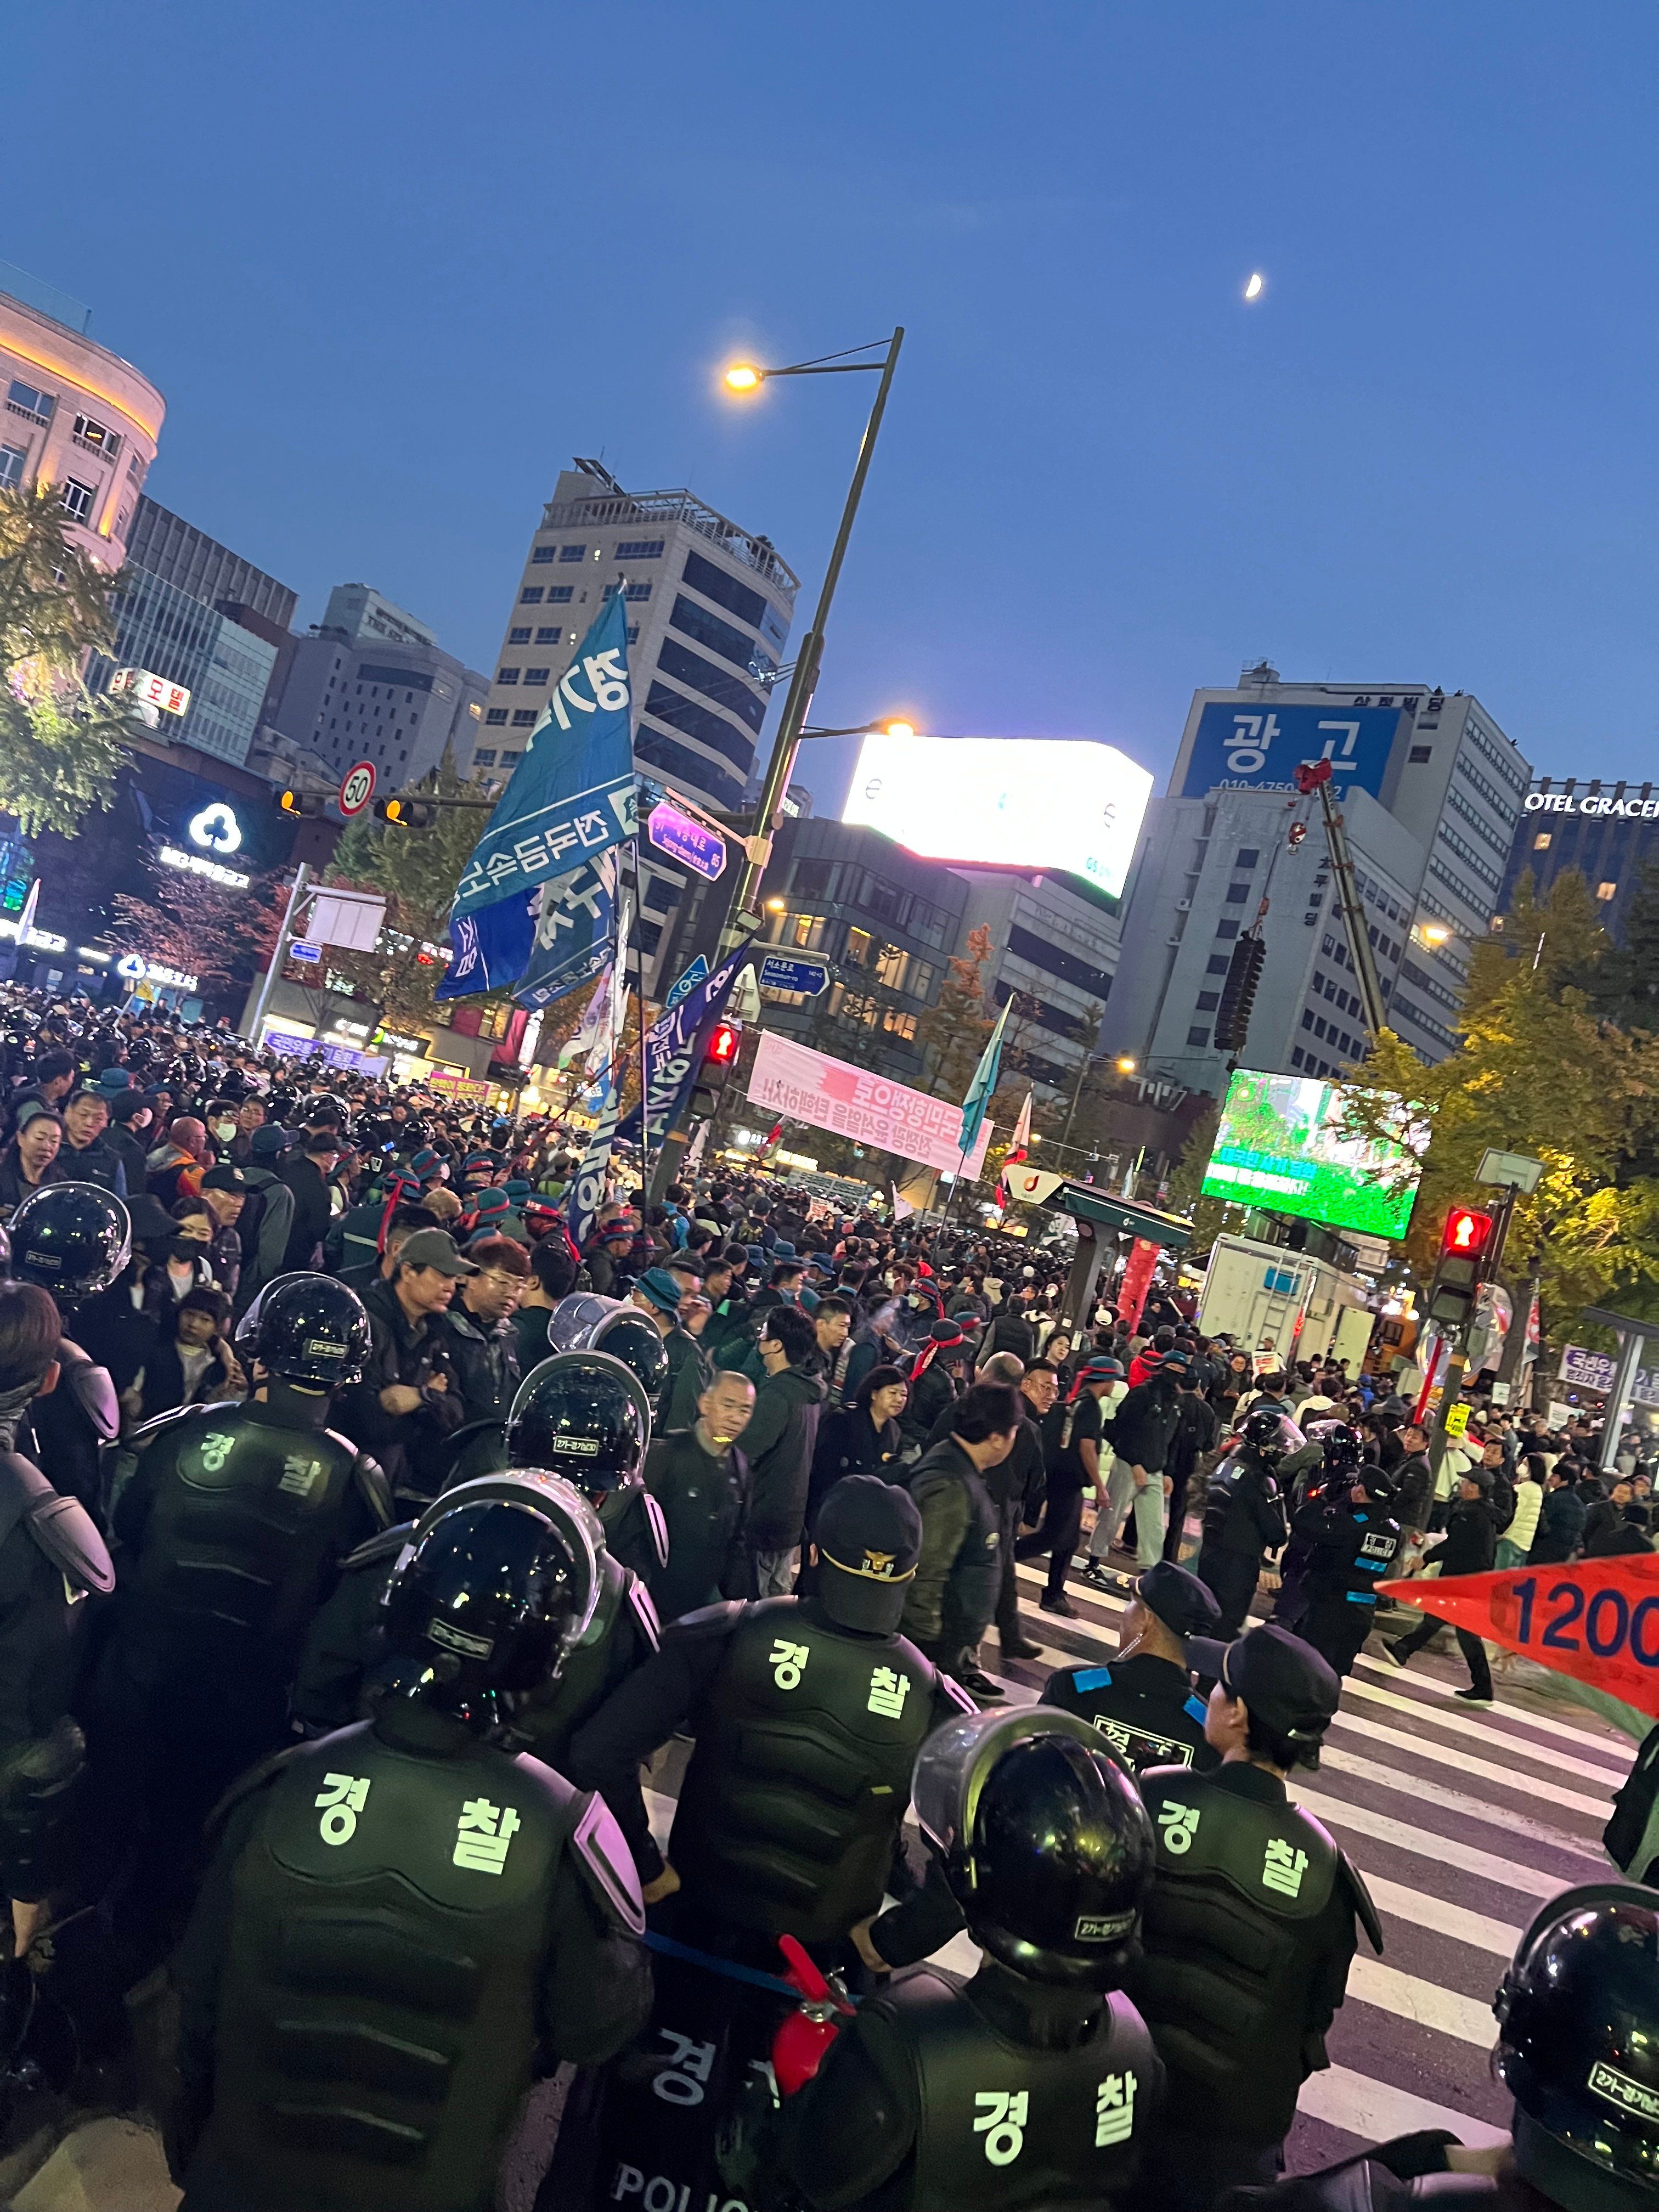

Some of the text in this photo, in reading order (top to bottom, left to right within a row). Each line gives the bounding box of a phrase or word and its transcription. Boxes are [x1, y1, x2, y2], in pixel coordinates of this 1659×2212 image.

[1223, 713, 1359, 774] 광고
[345, 776, 369, 803] 50
[1524, 793, 1576, 812] OTEL
[200, 1432, 321, 1496] 경 찰
[1513, 1578, 1659, 1667] 1200
[769, 1639, 910, 1719] 경 찰
[315, 1773, 521, 1875] 경 찰
[1158, 1800, 1308, 1898] 경 찰
[652, 2028, 716, 2106] 경
[973, 2071, 1137, 2166] 경 찰
[611, 2162, 749, 2212] POL
